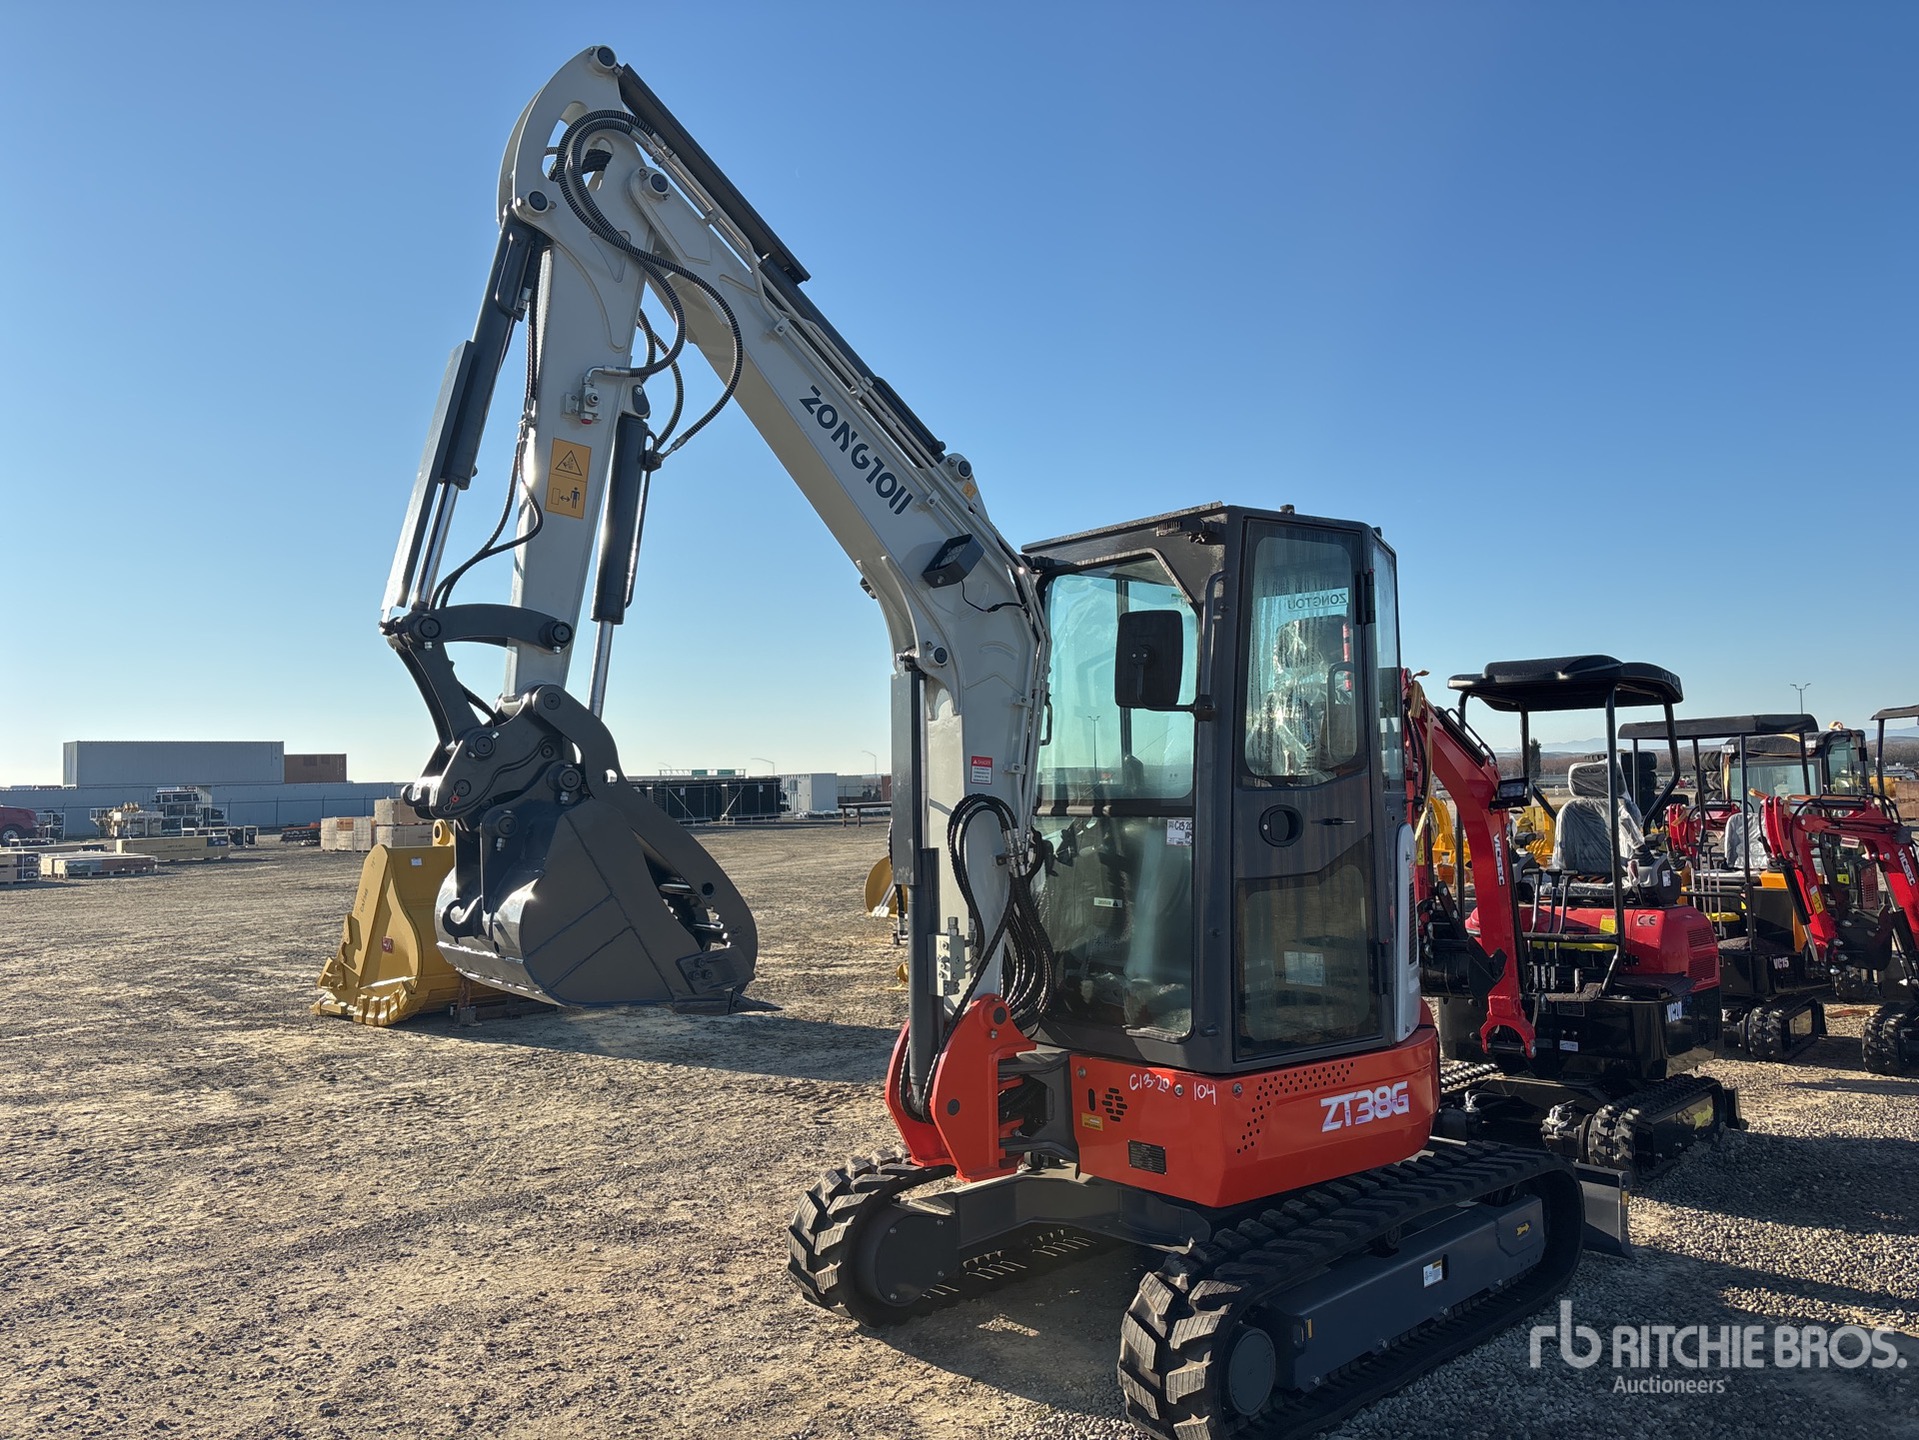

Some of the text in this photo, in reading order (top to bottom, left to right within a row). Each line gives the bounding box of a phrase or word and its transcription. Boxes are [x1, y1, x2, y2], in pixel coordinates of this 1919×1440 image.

[1637, 915, 1656, 926] CE
[1773, 956, 1789, 969] VC15
[1666, 1001, 1682, 1023] VC20
[1193, 1081, 1216, 1105] 104
[1320, 1081, 1409, 1132] ZT38G
